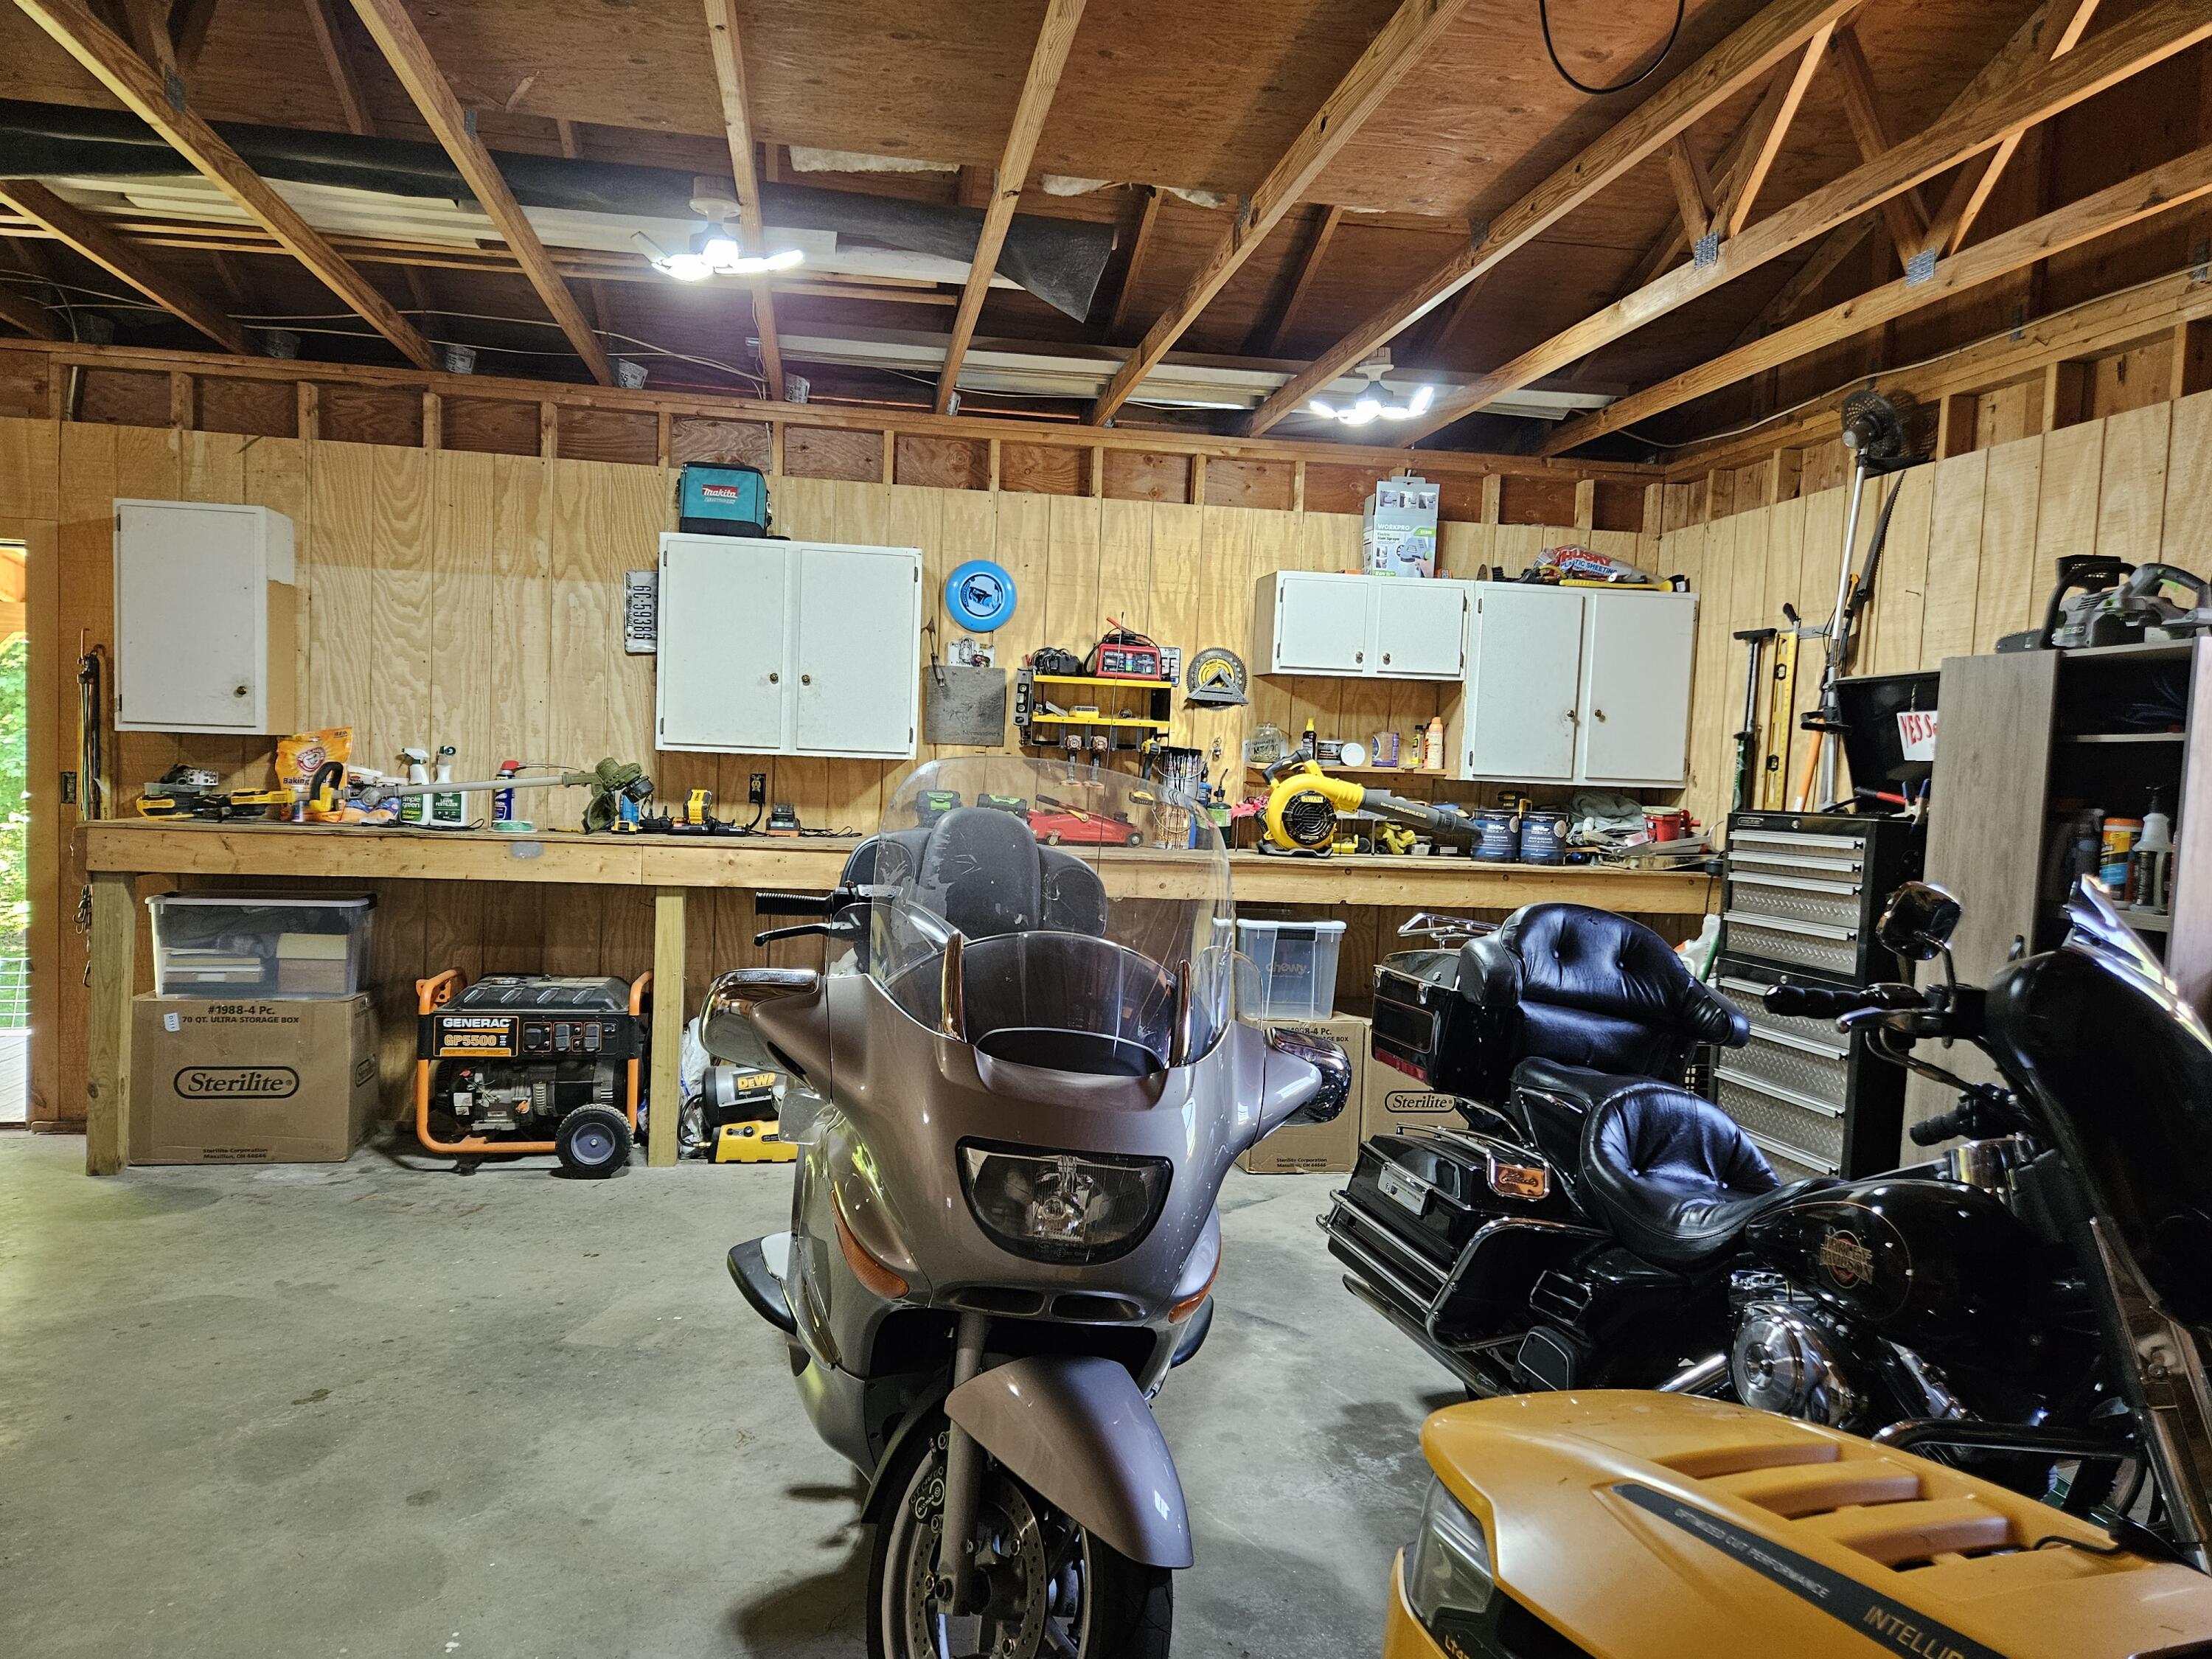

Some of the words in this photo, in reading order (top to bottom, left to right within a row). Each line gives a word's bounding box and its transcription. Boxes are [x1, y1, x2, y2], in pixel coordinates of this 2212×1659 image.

[1559, 549, 1612, 566] HUSKY
[2065, 626, 2084, 634] EGO
[1899, 714, 1923, 749] YES
[283, 777, 310, 785] Baking
[1394, 805, 1427, 818] BRUSHLESS
[1265, 961, 1307, 975] chewy
[207, 1006, 256, 1015] #1988-4
[259, 1006, 275, 1015] Pc.
[442, 1018, 511, 1028] GENERAC
[444, 1034, 497, 1046] GP5500
[188, 1071, 284, 1092] Sterilite
[738, 1073, 775, 1089] DEWA
[1392, 1094, 1447, 1108] Sterilite
[1725, 1534, 1750, 1552] CUT
[1747, 1548, 1830, 1599] PERFORMANCE
